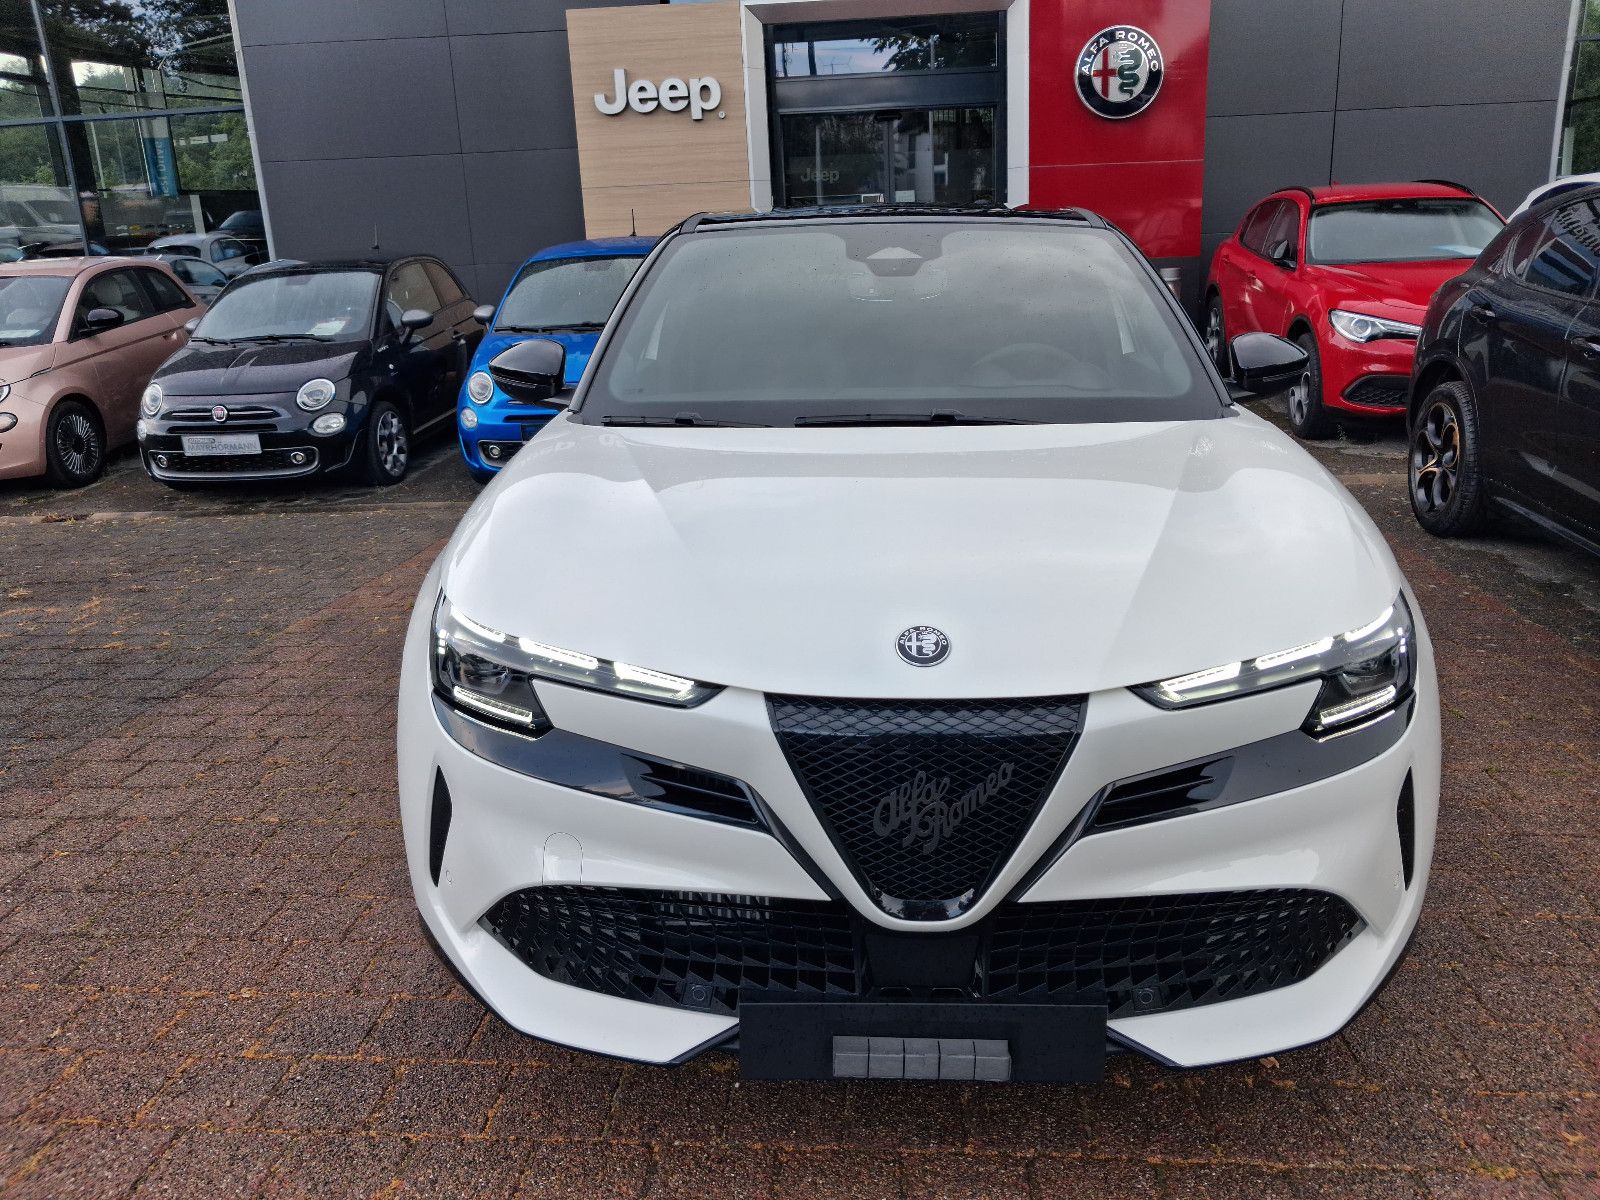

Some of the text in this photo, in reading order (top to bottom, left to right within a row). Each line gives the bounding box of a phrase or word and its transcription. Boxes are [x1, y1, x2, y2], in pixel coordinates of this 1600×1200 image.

[1081, 30, 1159, 75] ALFA ROMEO
[594, 68, 721, 121] Jeep
[801, 167, 840, 184] Jeep
[899, 626, 948, 646] ALFA ROMEO
[916, 762, 1015, 855] Romeo
